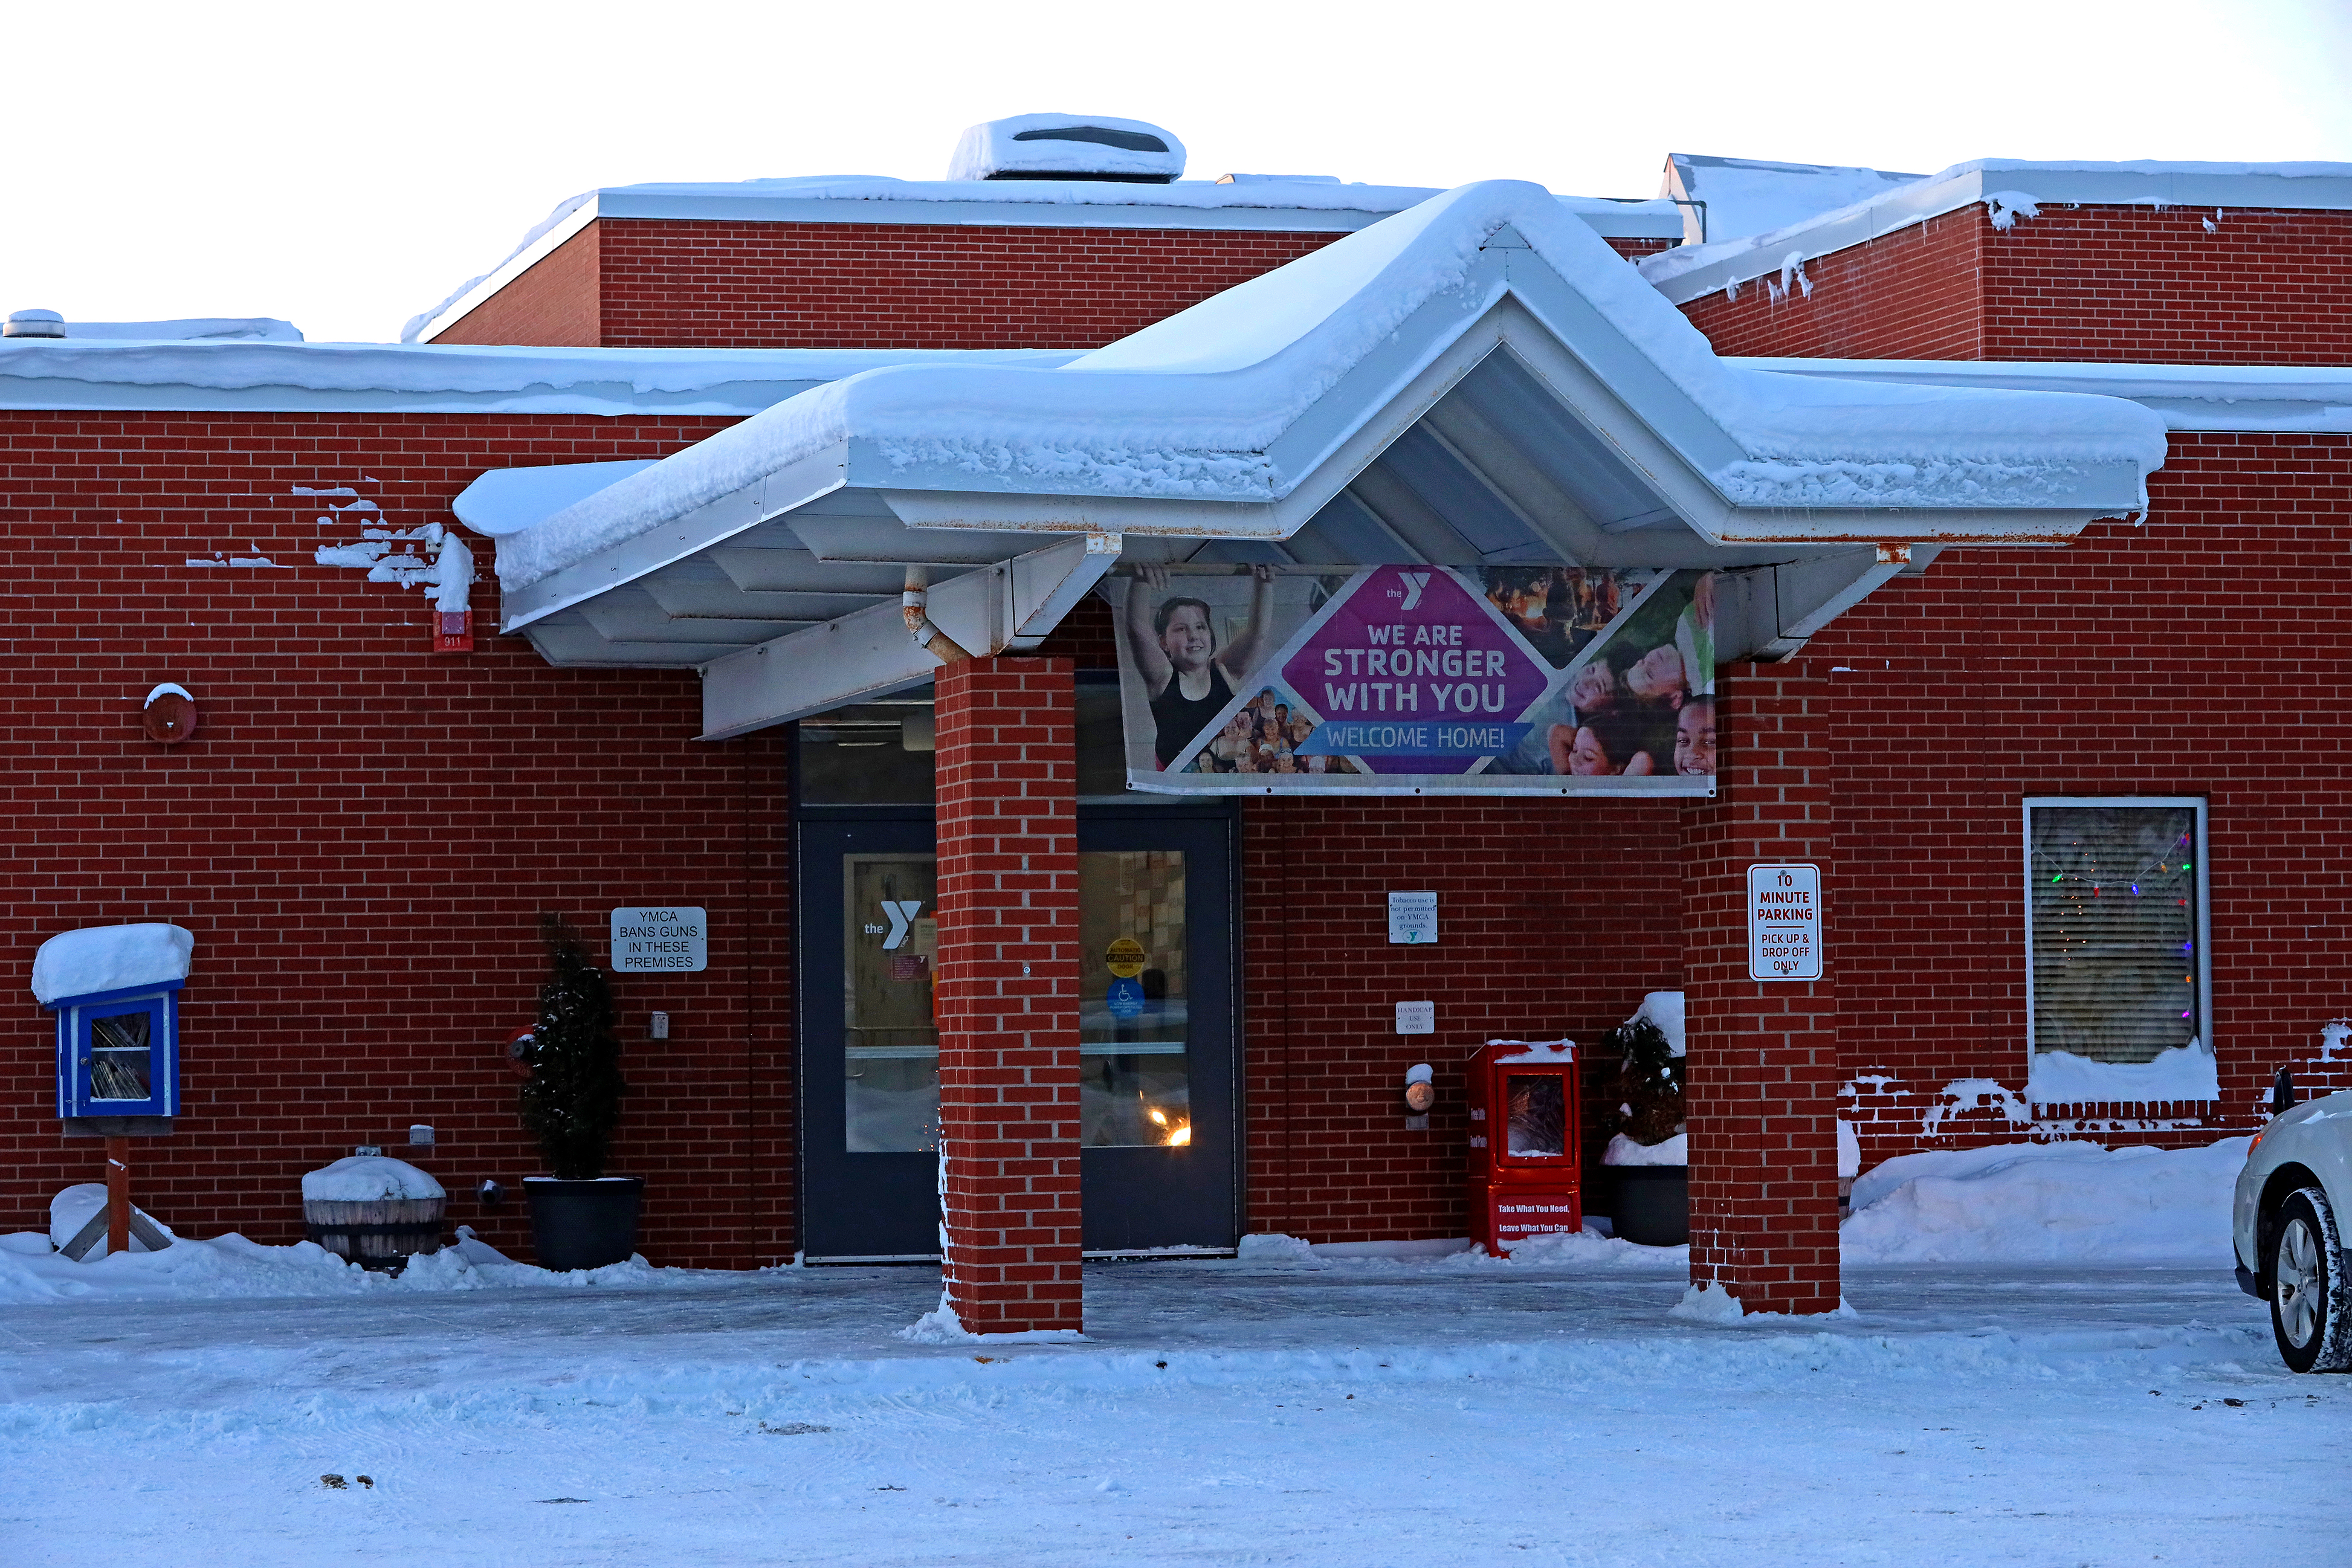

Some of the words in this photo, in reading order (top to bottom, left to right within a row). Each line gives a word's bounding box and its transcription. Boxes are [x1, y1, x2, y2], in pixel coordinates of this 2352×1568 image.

[1386, 589, 1401, 598] the
[1368, 625, 1405, 645] WE
[1413, 625, 1462, 645] ARE
[444, 636, 460, 647] 911
[1324, 648, 1507, 677] STRONGER
[1325, 682, 1418, 712] WITH
[1430, 682, 1505, 712] YOU
[1326, 727, 1427, 747] WELCOME
[1438, 727, 1504, 748] HOME!
[1777, 875, 1792, 886] 10
[1760, 892, 1809, 903] MINUTE
[639, 911, 678, 922] YMCA
[1758, 908, 1812, 920] PARKING
[620, 926, 656, 937] BANS
[660, 926, 697, 937] GUNS
[864, 923, 884, 934] the
[1399, 922, 1427, 931] grounds.
[899, 935, 909, 947] YMCA
[1762, 934, 1783, 943] PICK
[1786, 934, 1800, 943] UP
[1803, 934, 1809, 943] &
[629, 942, 641, 952] IN
[645, 941, 689, 952] THESE
[1762, 947, 1789, 957] DROP
[1792, 947, 1809, 957] OFF
[625, 957, 693, 968] PREMISES
[1773, 961, 1799, 970] ONLY
[1550, 1204, 1570, 1213] Need,
